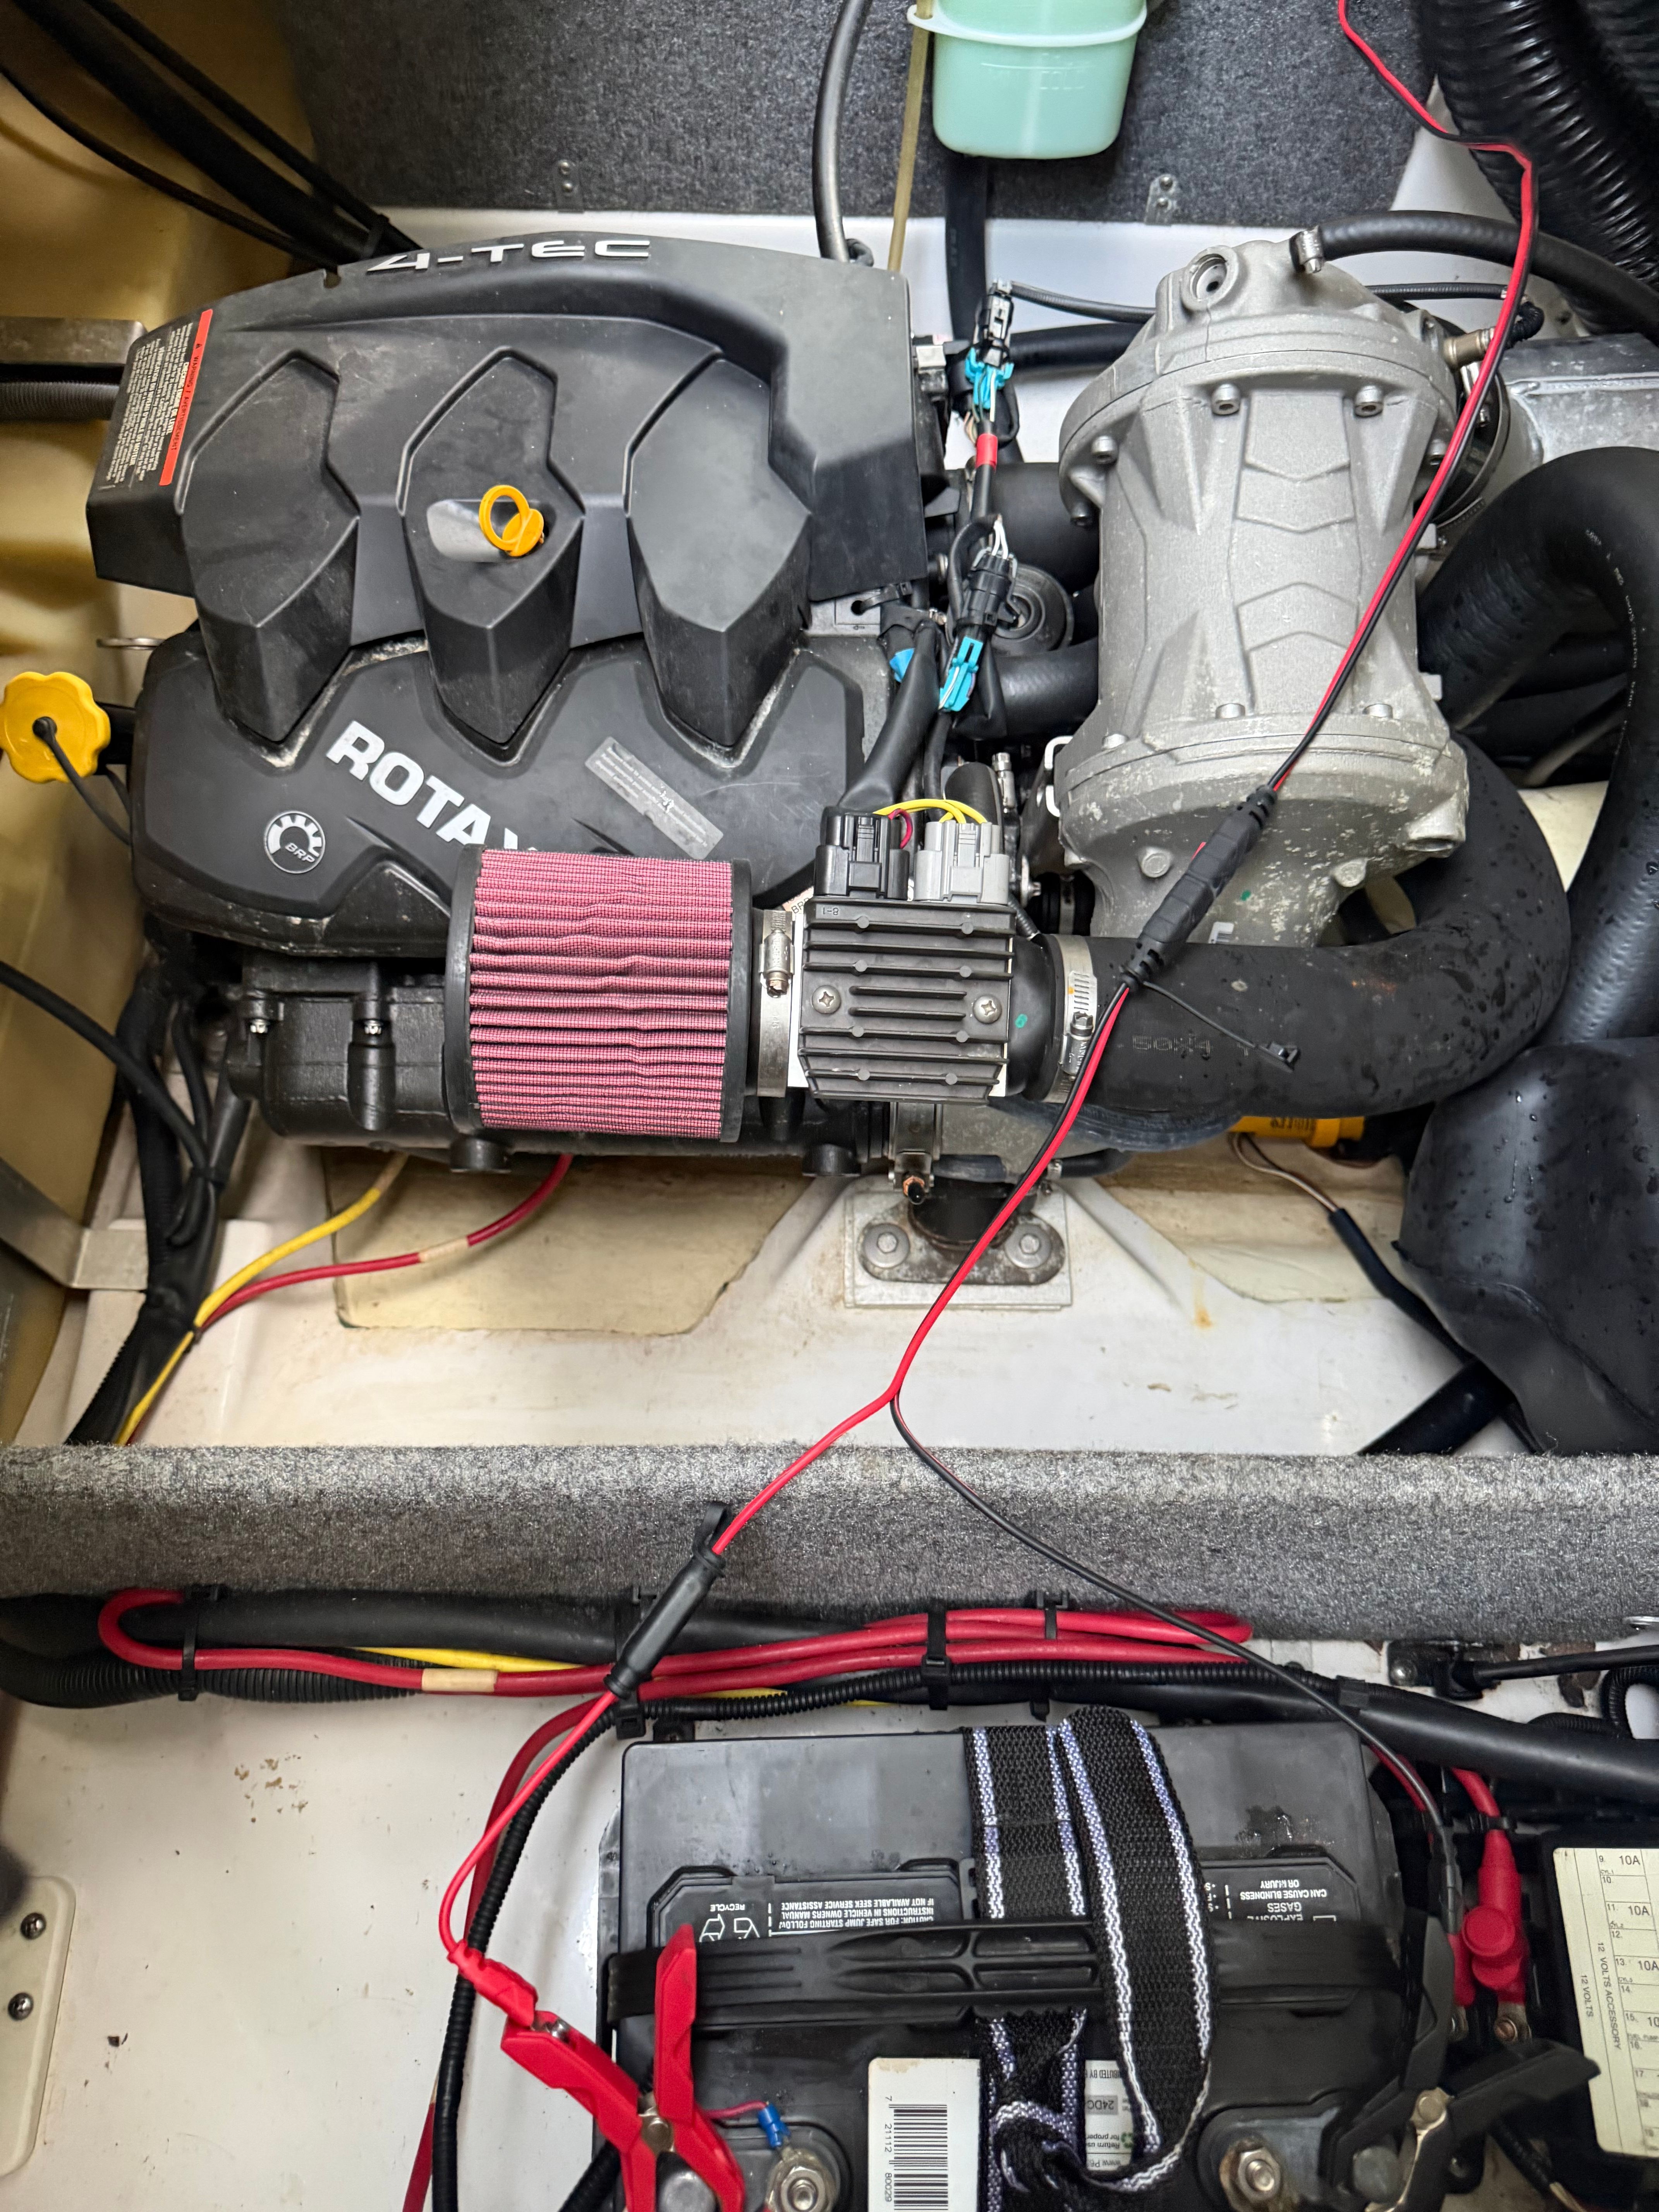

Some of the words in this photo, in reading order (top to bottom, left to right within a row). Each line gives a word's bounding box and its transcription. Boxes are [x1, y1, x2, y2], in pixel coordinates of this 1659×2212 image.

[367, 240, 650, 272] 4-TEC
[187, 356, 199, 387] WARNING
[129, 442, 141, 465] MOTEUR
[326, 720, 518, 850] ROTA
[285, 842, 315, 863] BRP
[1619, 1855, 1640, 1865] 10A
[1288, 1879, 1299, 1887] OR
[1240, 1891, 1282, 1900] BLINDNESS
[1283, 1889, 1309, 1899] CAUSE
[1310, 1889, 1326, 1898] CAN
[710, 1903, 745, 1911] RECYCLE
[781, 1901, 822, 1910] ASSISTANCE
[824, 1900, 853, 1908] SERVICE
[873, 1898, 909, 1907] AVAILABLE
[1267, 1901, 1302, 1912] GASES
[781, 1911, 810, 1919] MANUAL
[812, 1910, 842, 1918] OWNERS
[843, 1909, 872, 1918] VEHICLE
[883, 1907, 933, 1916] INSTRUCTIONS
[1628, 1906, 1650, 1916] 10A
[809, 1919, 843, 1928] STARTING
[845, 1918, 864, 1927] JUMP
[866, 1918, 883, 1926] SAFE
[885, 1917, 899, 1925] FOR
[1598, 1943, 1605, 1952] 12
[1638, 1960, 1659, 1971] 10A
[1600, 1957, 1611, 1987] VOLTS
[1580, 1975, 1588, 1985] 12
[1583, 1987, 1594, 2017] VOLTS
[1605, 1990, 1621, 2050] ACCESSORY
[1089, 2069, 1097, 2078] BY
